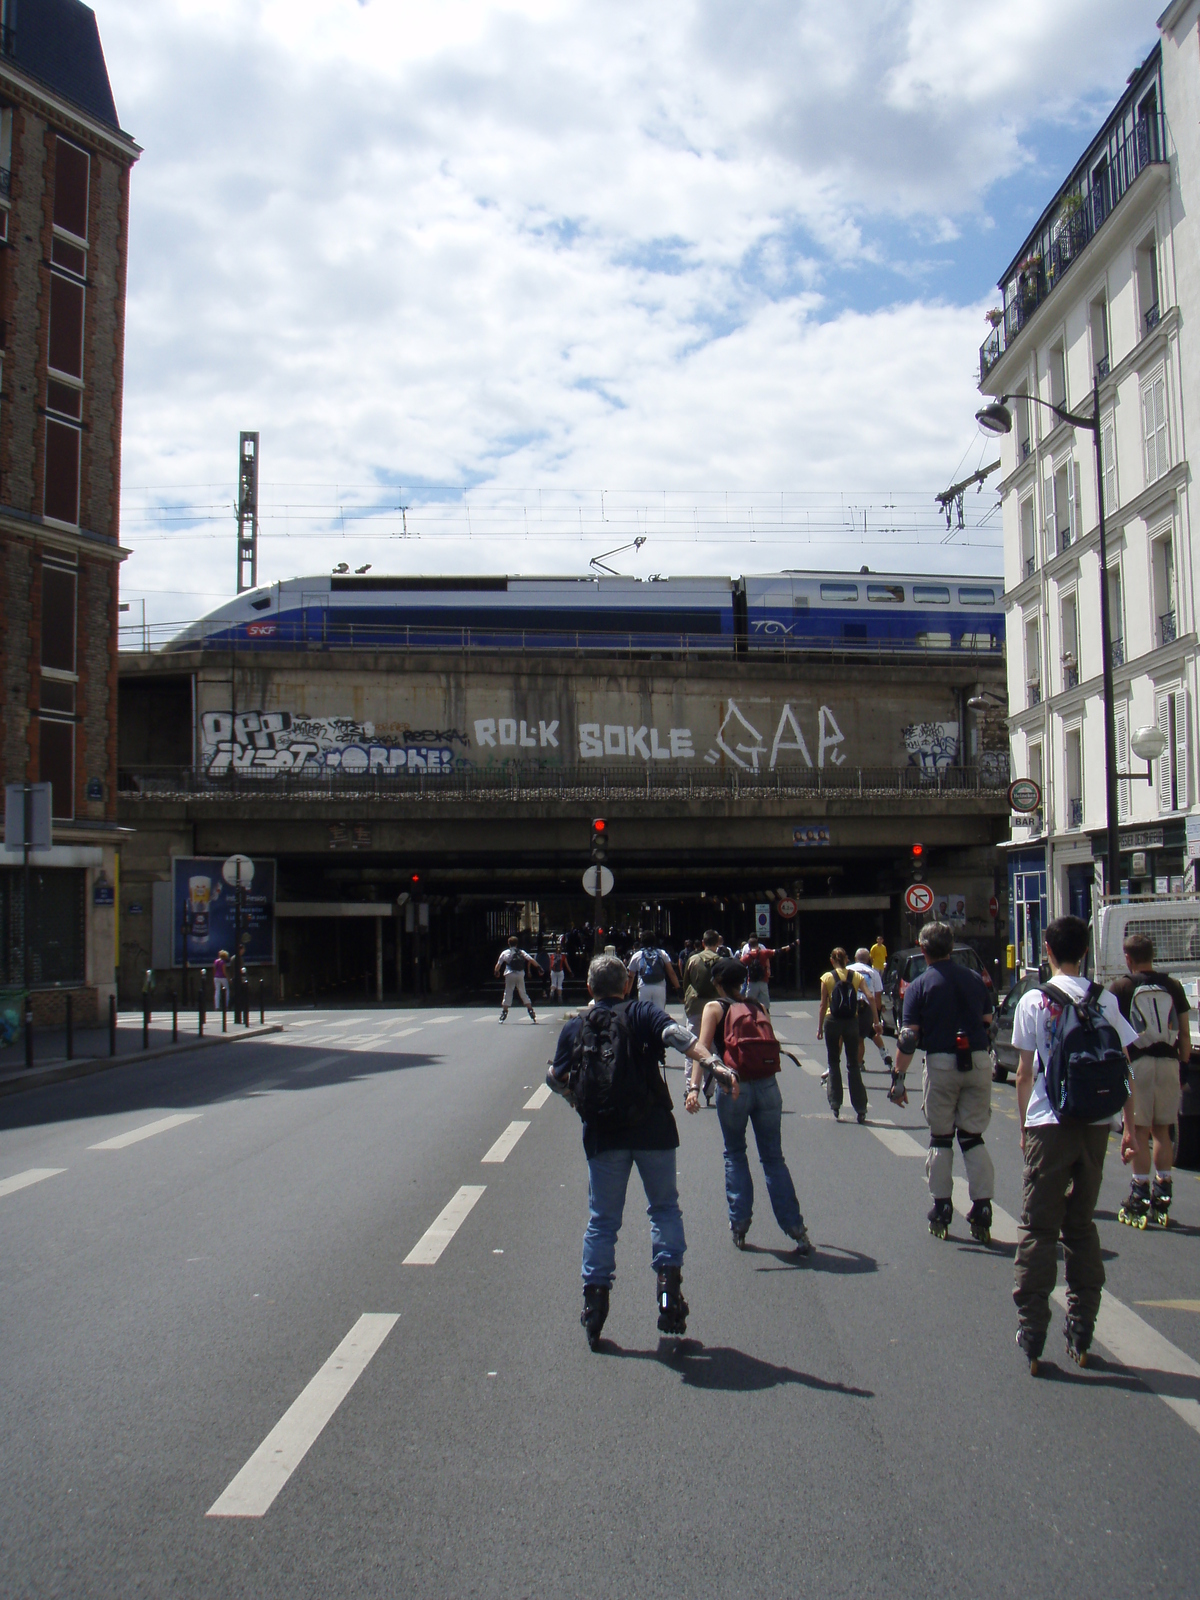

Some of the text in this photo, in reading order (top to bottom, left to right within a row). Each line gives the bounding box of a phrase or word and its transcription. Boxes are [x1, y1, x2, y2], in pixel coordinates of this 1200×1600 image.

[249, 626, 277, 635] SNCF
[751, 620, 798, 634] TGV
[579, 723, 695, 760] SOKLE
[1015, 817, 1035, 826] BAR
